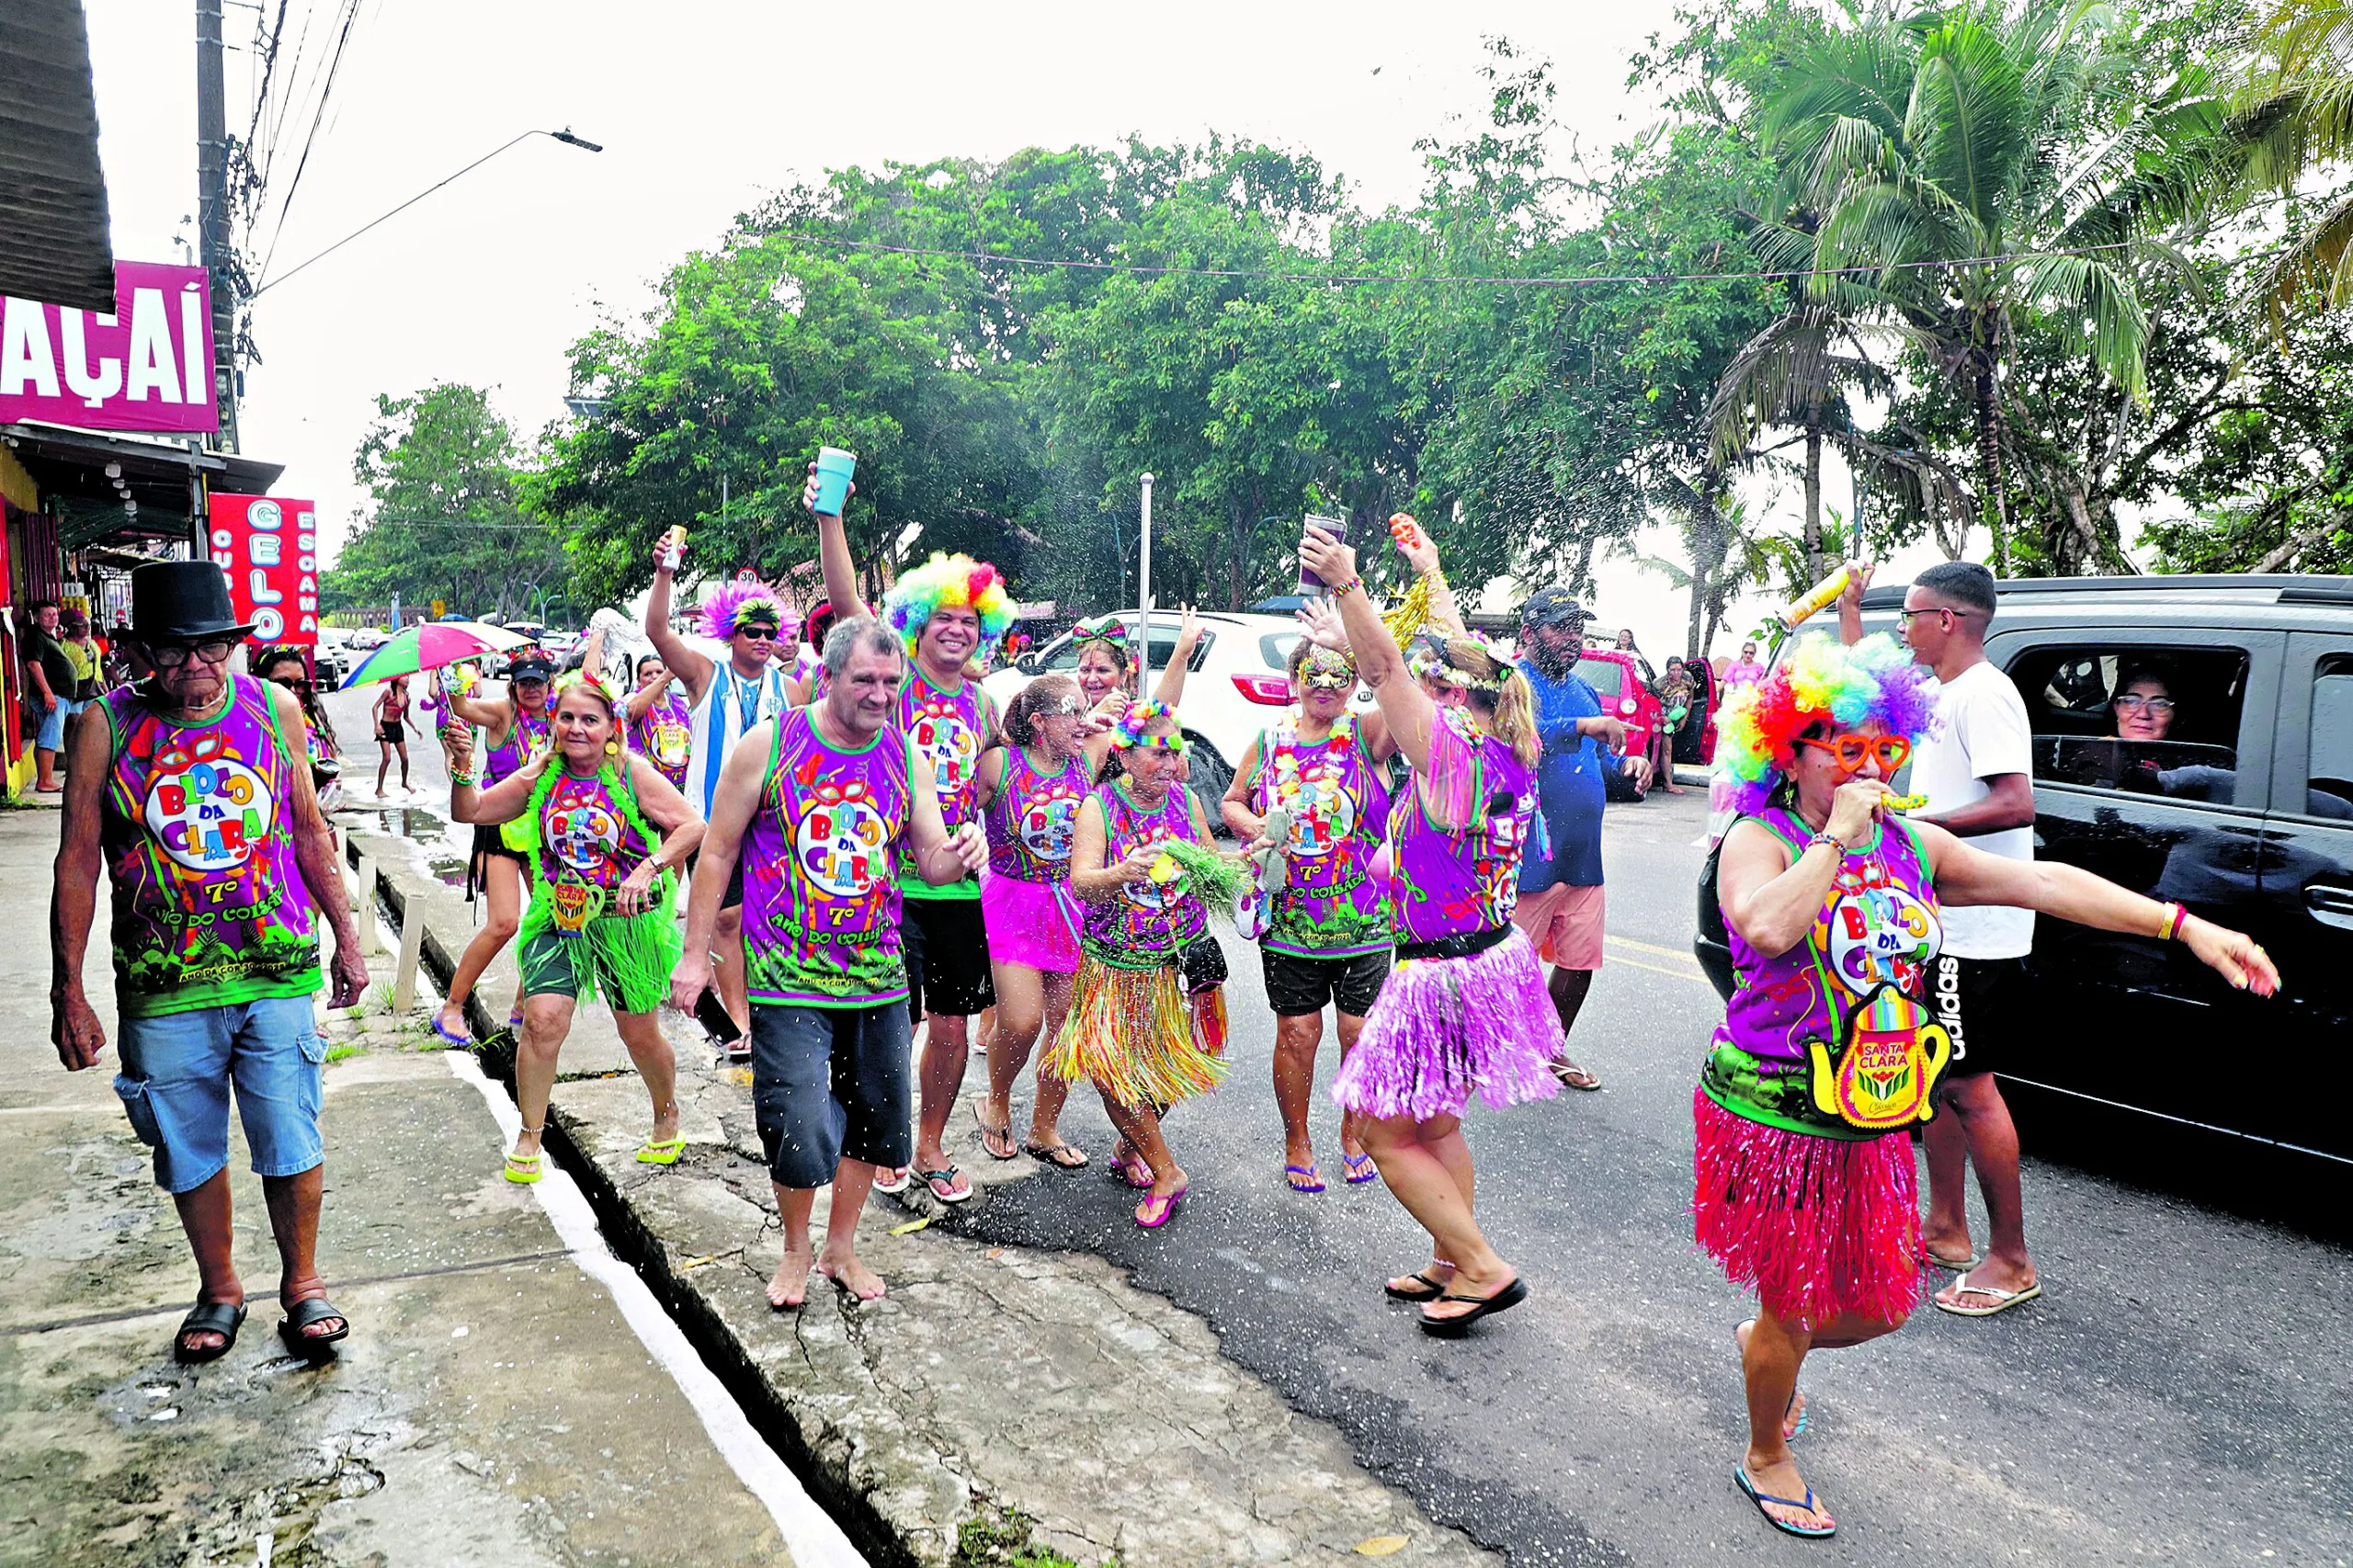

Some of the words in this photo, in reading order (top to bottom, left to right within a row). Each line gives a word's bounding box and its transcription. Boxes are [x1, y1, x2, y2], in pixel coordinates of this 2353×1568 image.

[0, 281, 208, 408] AÇAÍ
[247, 499, 283, 642] GELO
[297, 511, 316, 632] ESCAMA
[741, 572, 755, 582] 30
[917, 717, 972, 755] BLOCO
[938, 744, 951, 758] DA
[156, 763, 254, 816] BLOCO
[199, 804, 226, 820] DA
[552, 807, 608, 835] BLOCO
[811, 801, 881, 846] BLOCO
[161, 808, 264, 861] CLARA
[574, 831, 588, 840] DA
[837, 837, 858, 852] DA
[1290, 815, 1345, 849] LARA
[554, 838, 611, 863] CLARA
[805, 846, 883, 887] CLARA
[1310, 870, 1366, 899] COISADO
[188, 912, 216, 926] DO
[770, 913, 804, 937] ANO
[808, 929, 832, 944] DO
[1840, 889, 1928, 939] BLOCO
[1878, 933, 1902, 950] DA
[1935, 957, 1966, 1061] adidas
[1859, 1054, 1908, 1069] CLARA
[1864, 1044, 1904, 1056] SANTA
